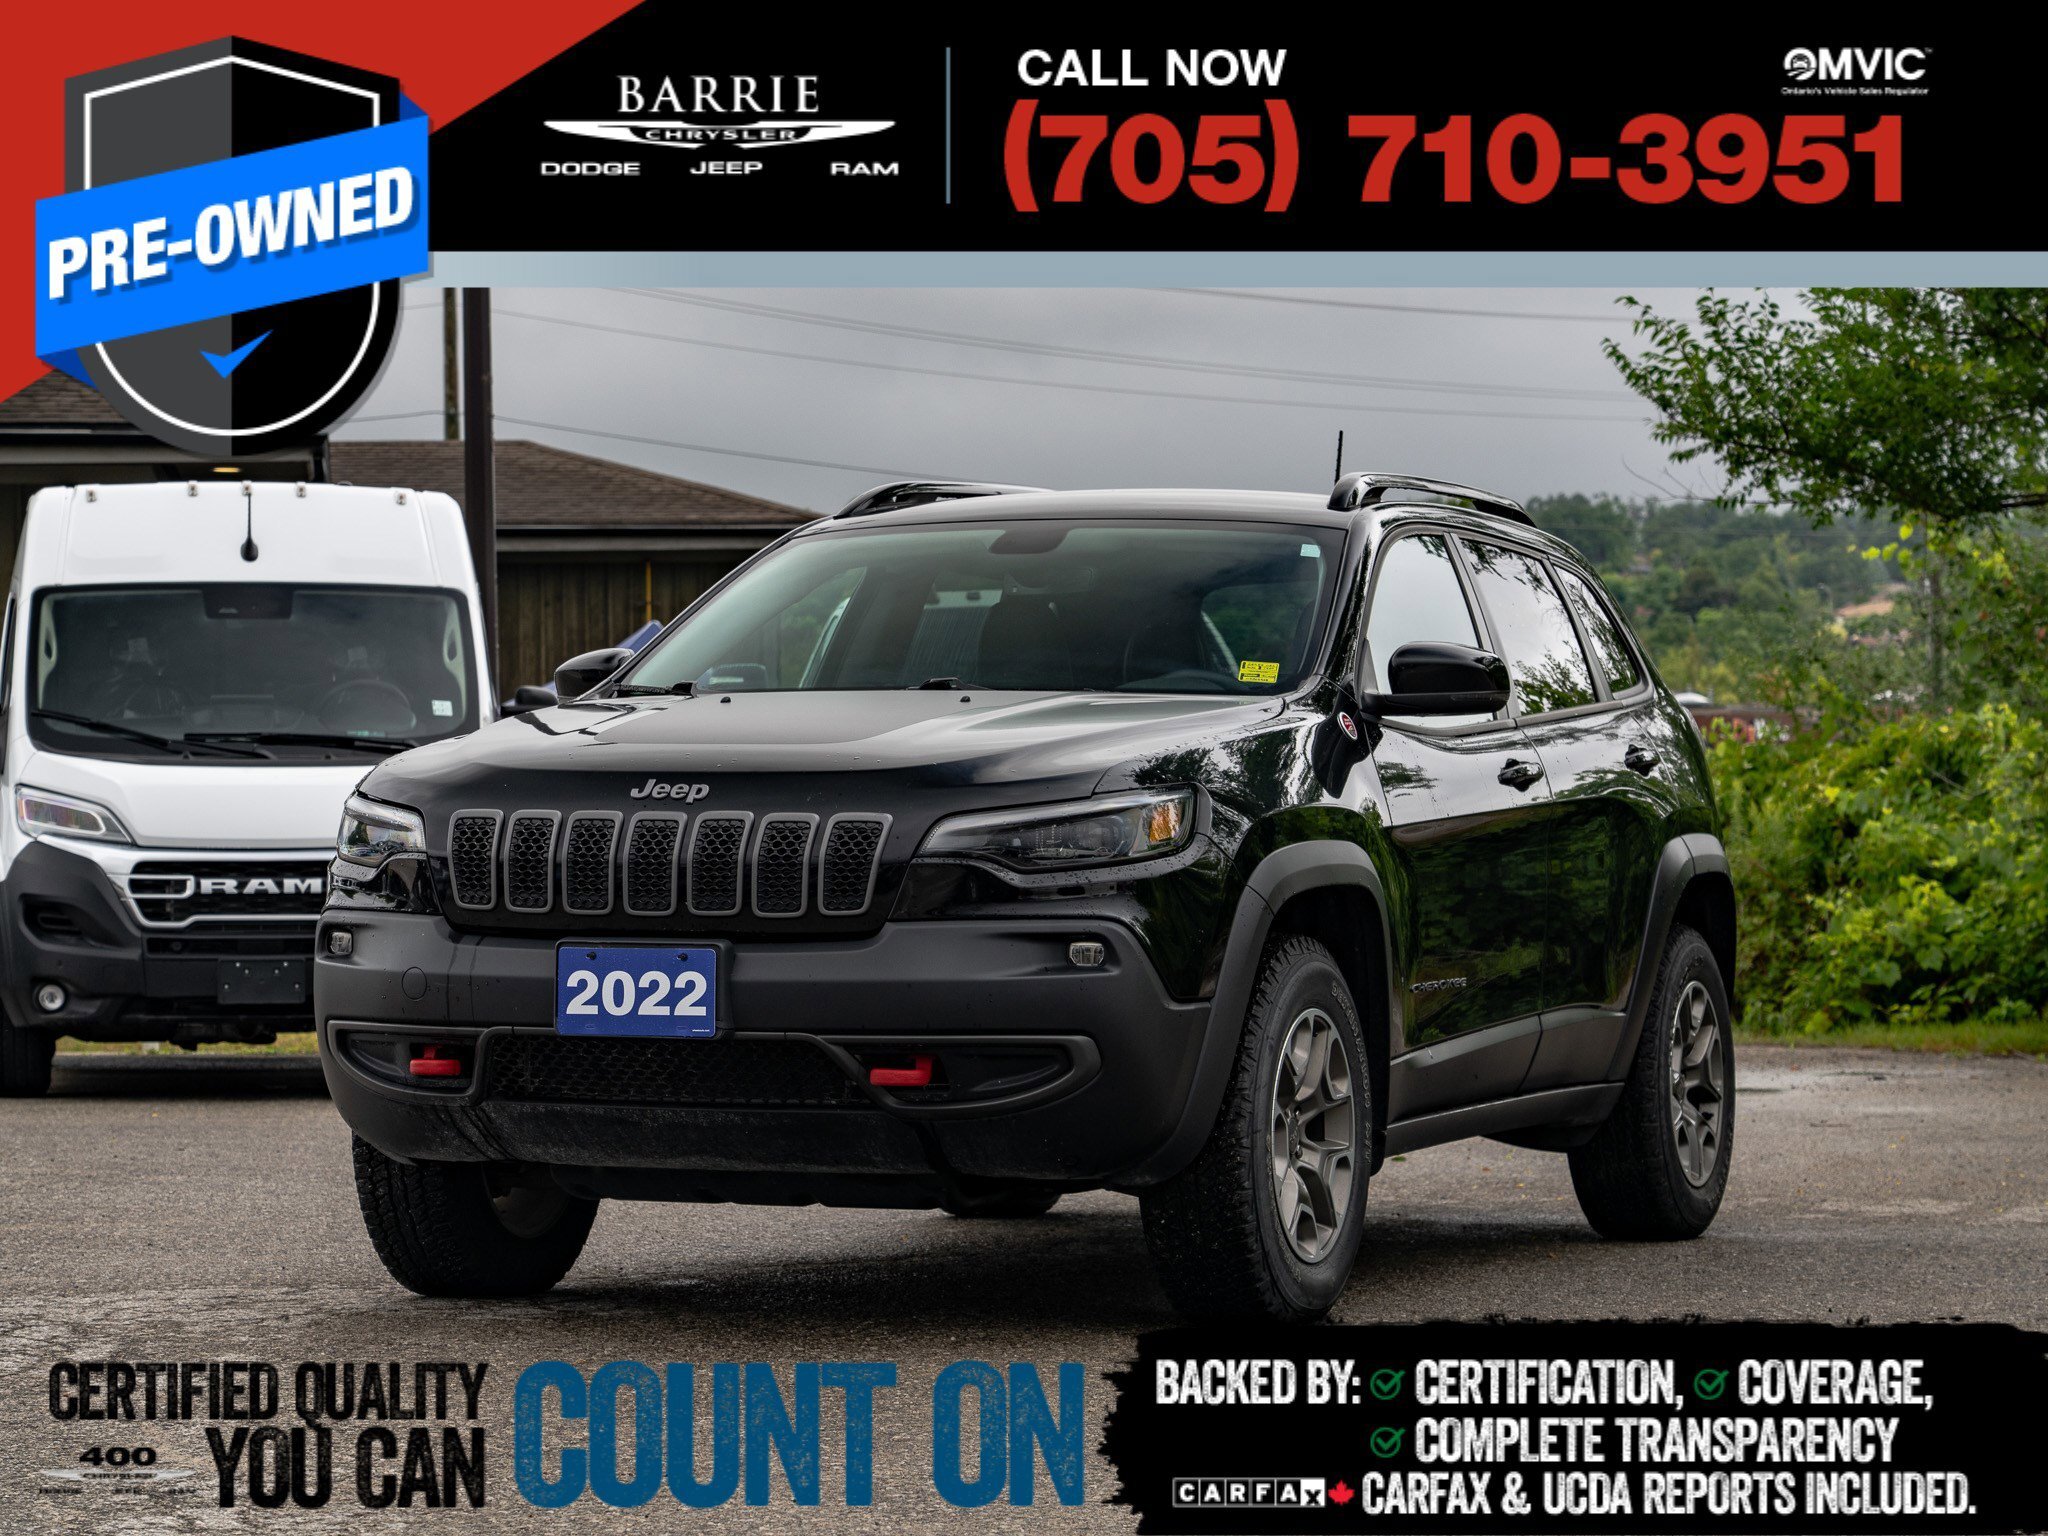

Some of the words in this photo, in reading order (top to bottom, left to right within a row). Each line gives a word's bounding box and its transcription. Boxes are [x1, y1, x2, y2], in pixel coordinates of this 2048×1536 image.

[630, 778, 710, 803] Jeep
[199, 878, 322, 894] RAM
[565, 969, 707, 1016] 2022
